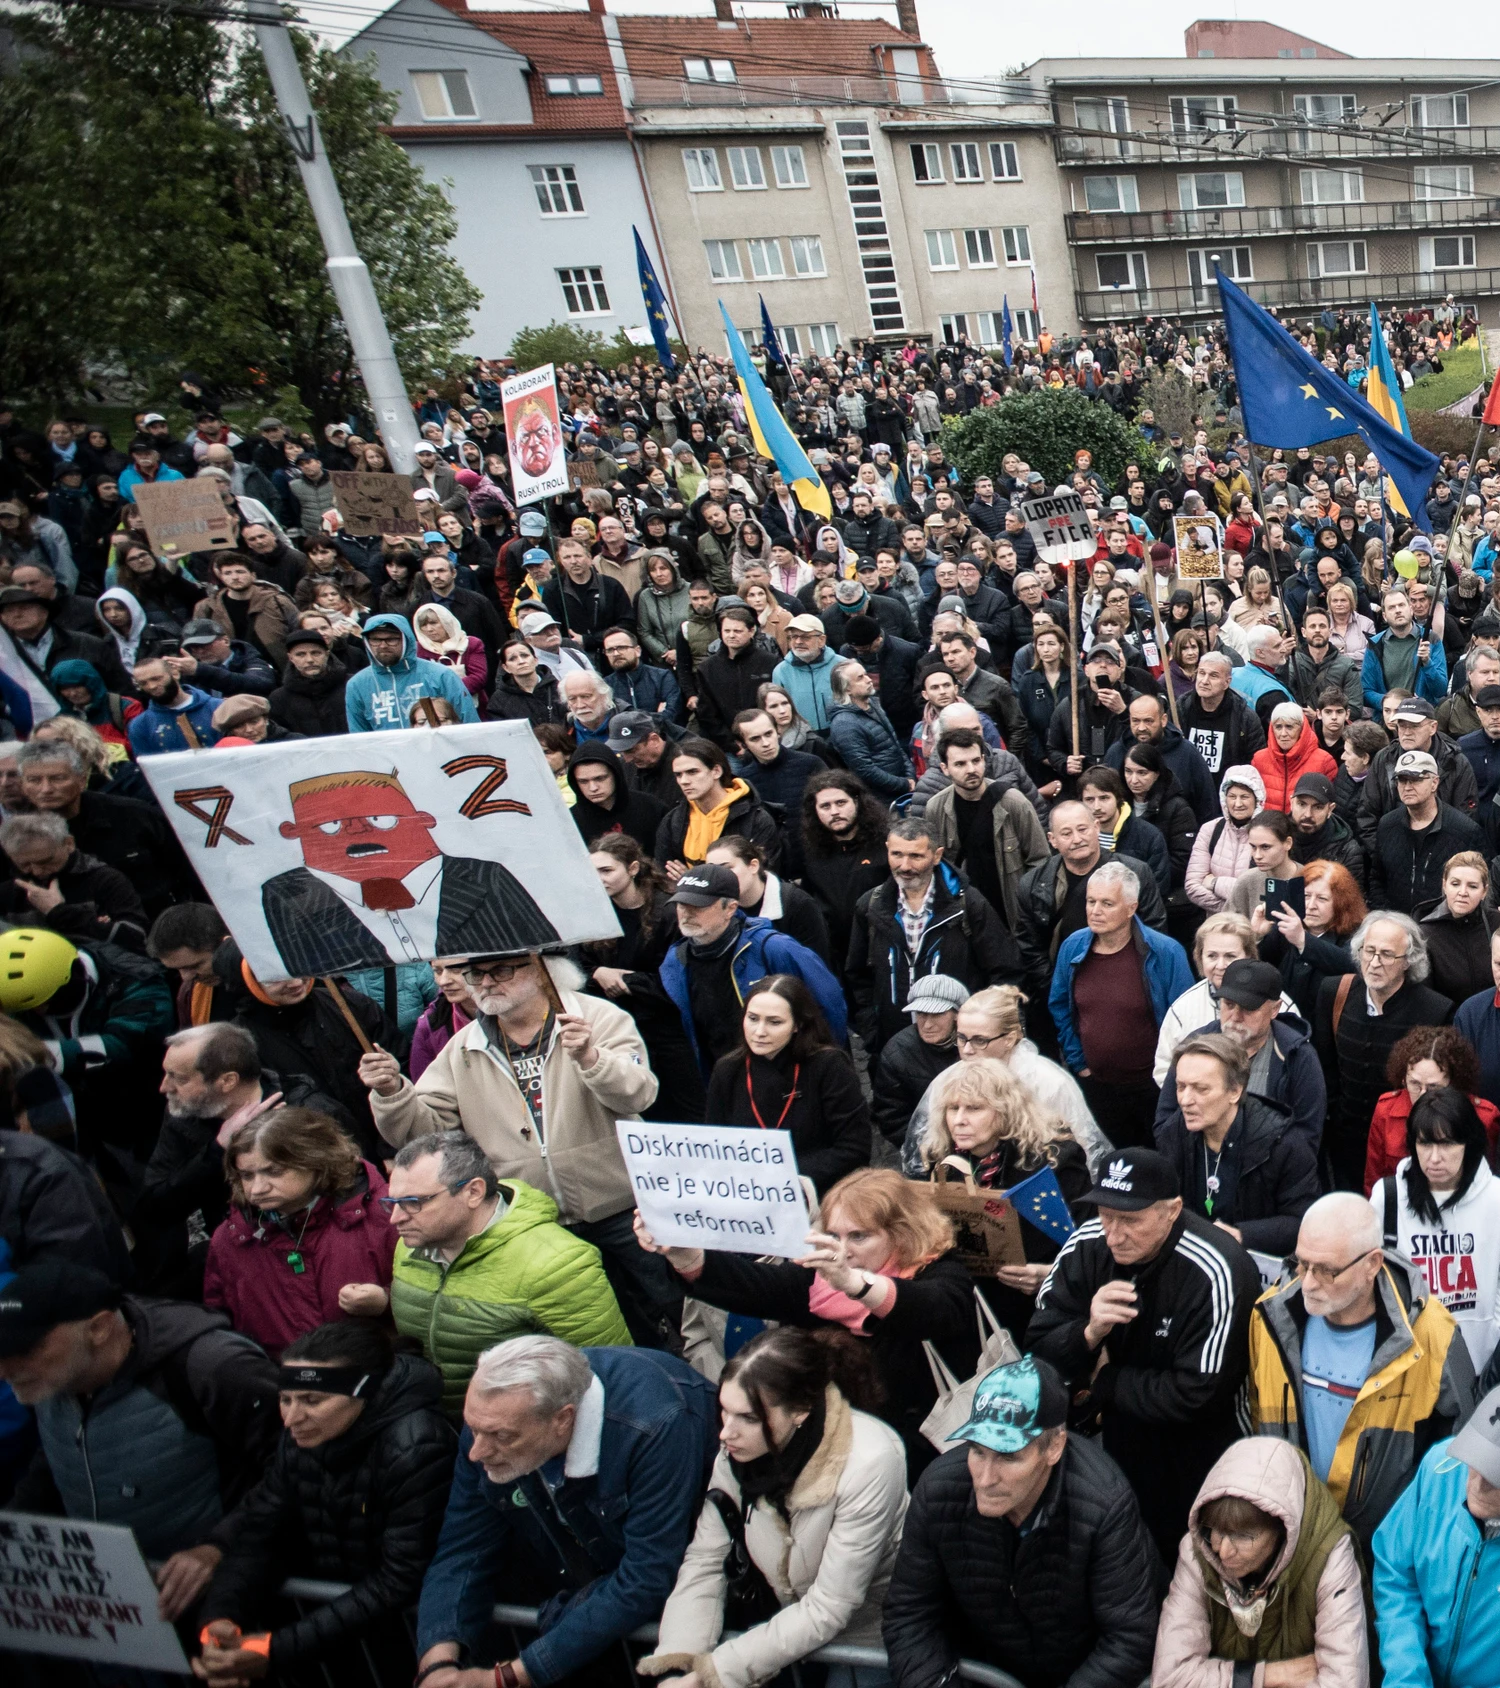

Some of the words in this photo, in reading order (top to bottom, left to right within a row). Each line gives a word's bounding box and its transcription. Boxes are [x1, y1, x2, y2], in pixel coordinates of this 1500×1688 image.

[504, 372, 551, 397] KOLABORANT
[334, 473, 359, 489] OFF
[518, 484, 541, 500] RUSKÝ
[541, 477, 565, 492] TROLL
[1023, 494, 1085, 522] LOPATA
[1048, 514, 1073, 528] PRE
[1043, 523, 1093, 547] FICA
[372, 682, 424, 710] MEAT
[627, 1133, 784, 1165] Diskriminácia
[635, 1172, 669, 1191] nie
[676, 1172, 695, 1198] je
[703, 1176, 797, 1203] volebná
[1101, 1177, 1133, 1192] adidas
[674, 1209, 776, 1235] reforma!
